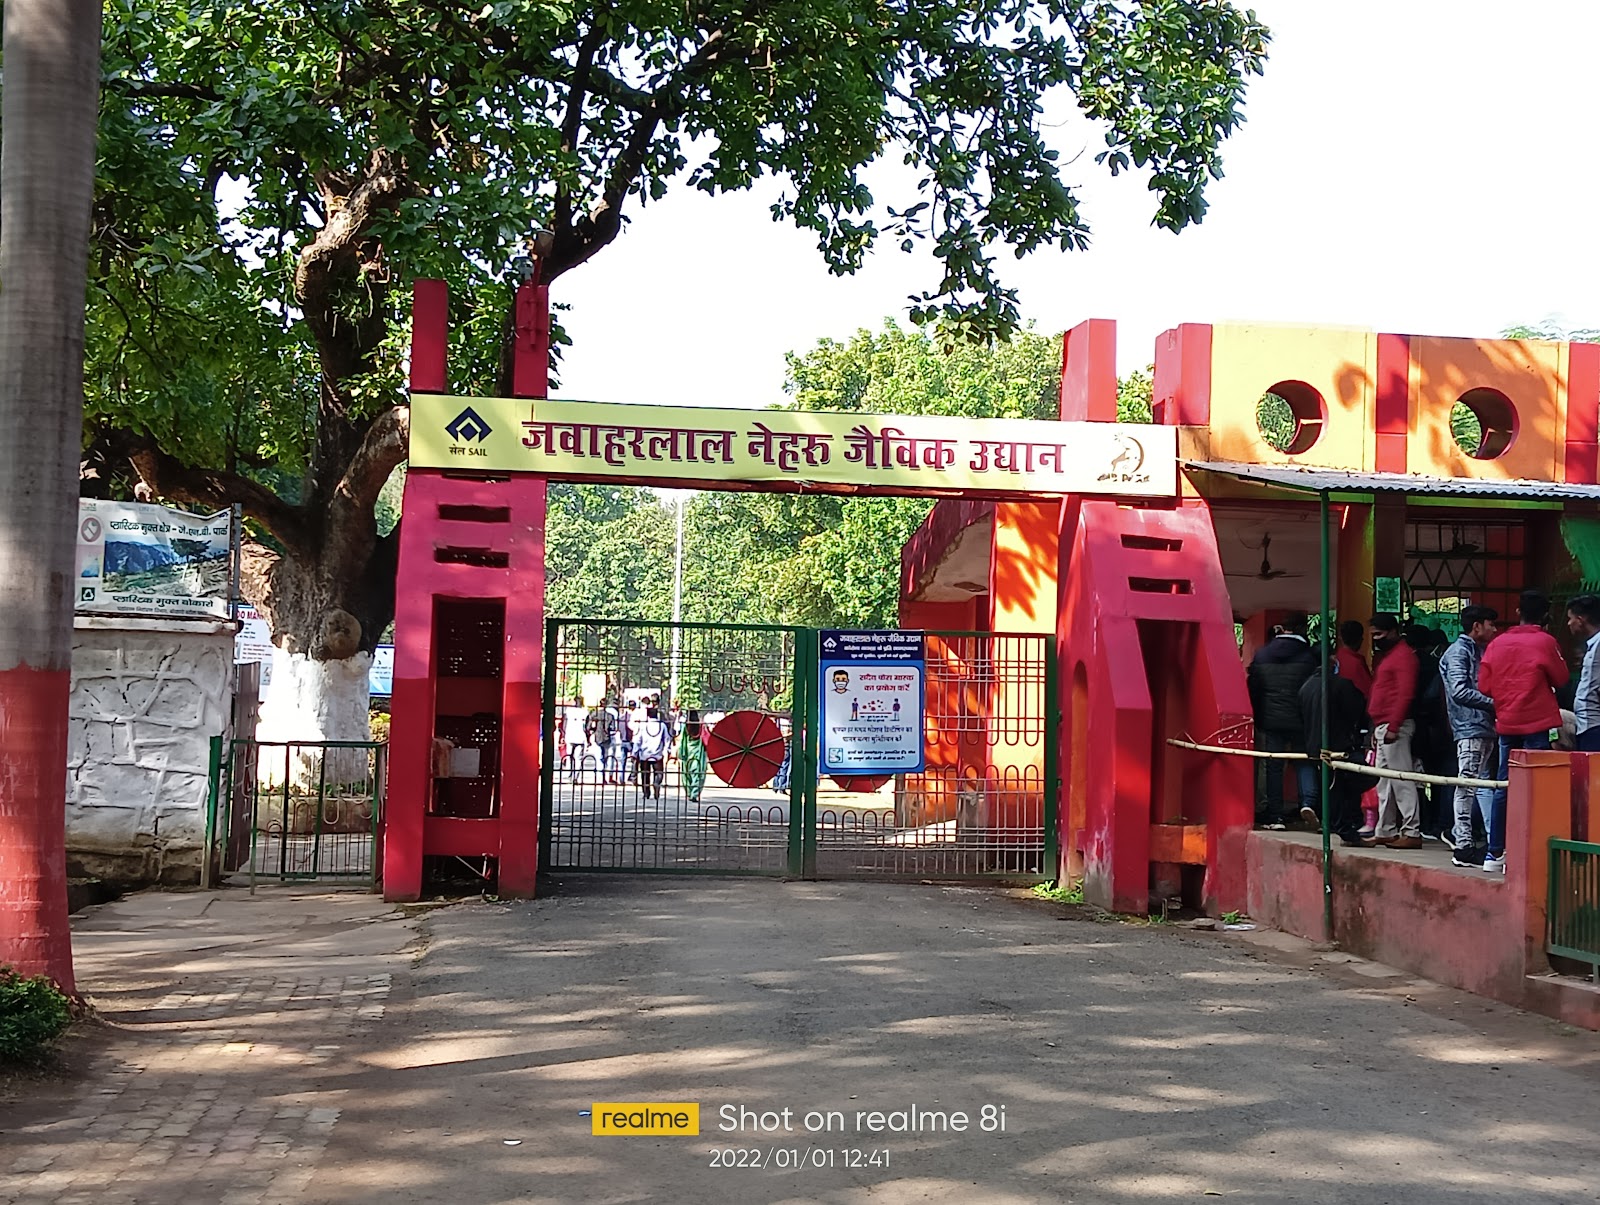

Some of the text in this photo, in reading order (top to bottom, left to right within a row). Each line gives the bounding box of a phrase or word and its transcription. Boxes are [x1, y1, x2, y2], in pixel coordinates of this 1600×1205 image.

[448, 443, 488, 457] सेल SAIL
[521, 421, 737, 467] जवाहरलाल
[843, 425, 958, 472] जैविक
[969, 440, 1067, 474] उद्यान
